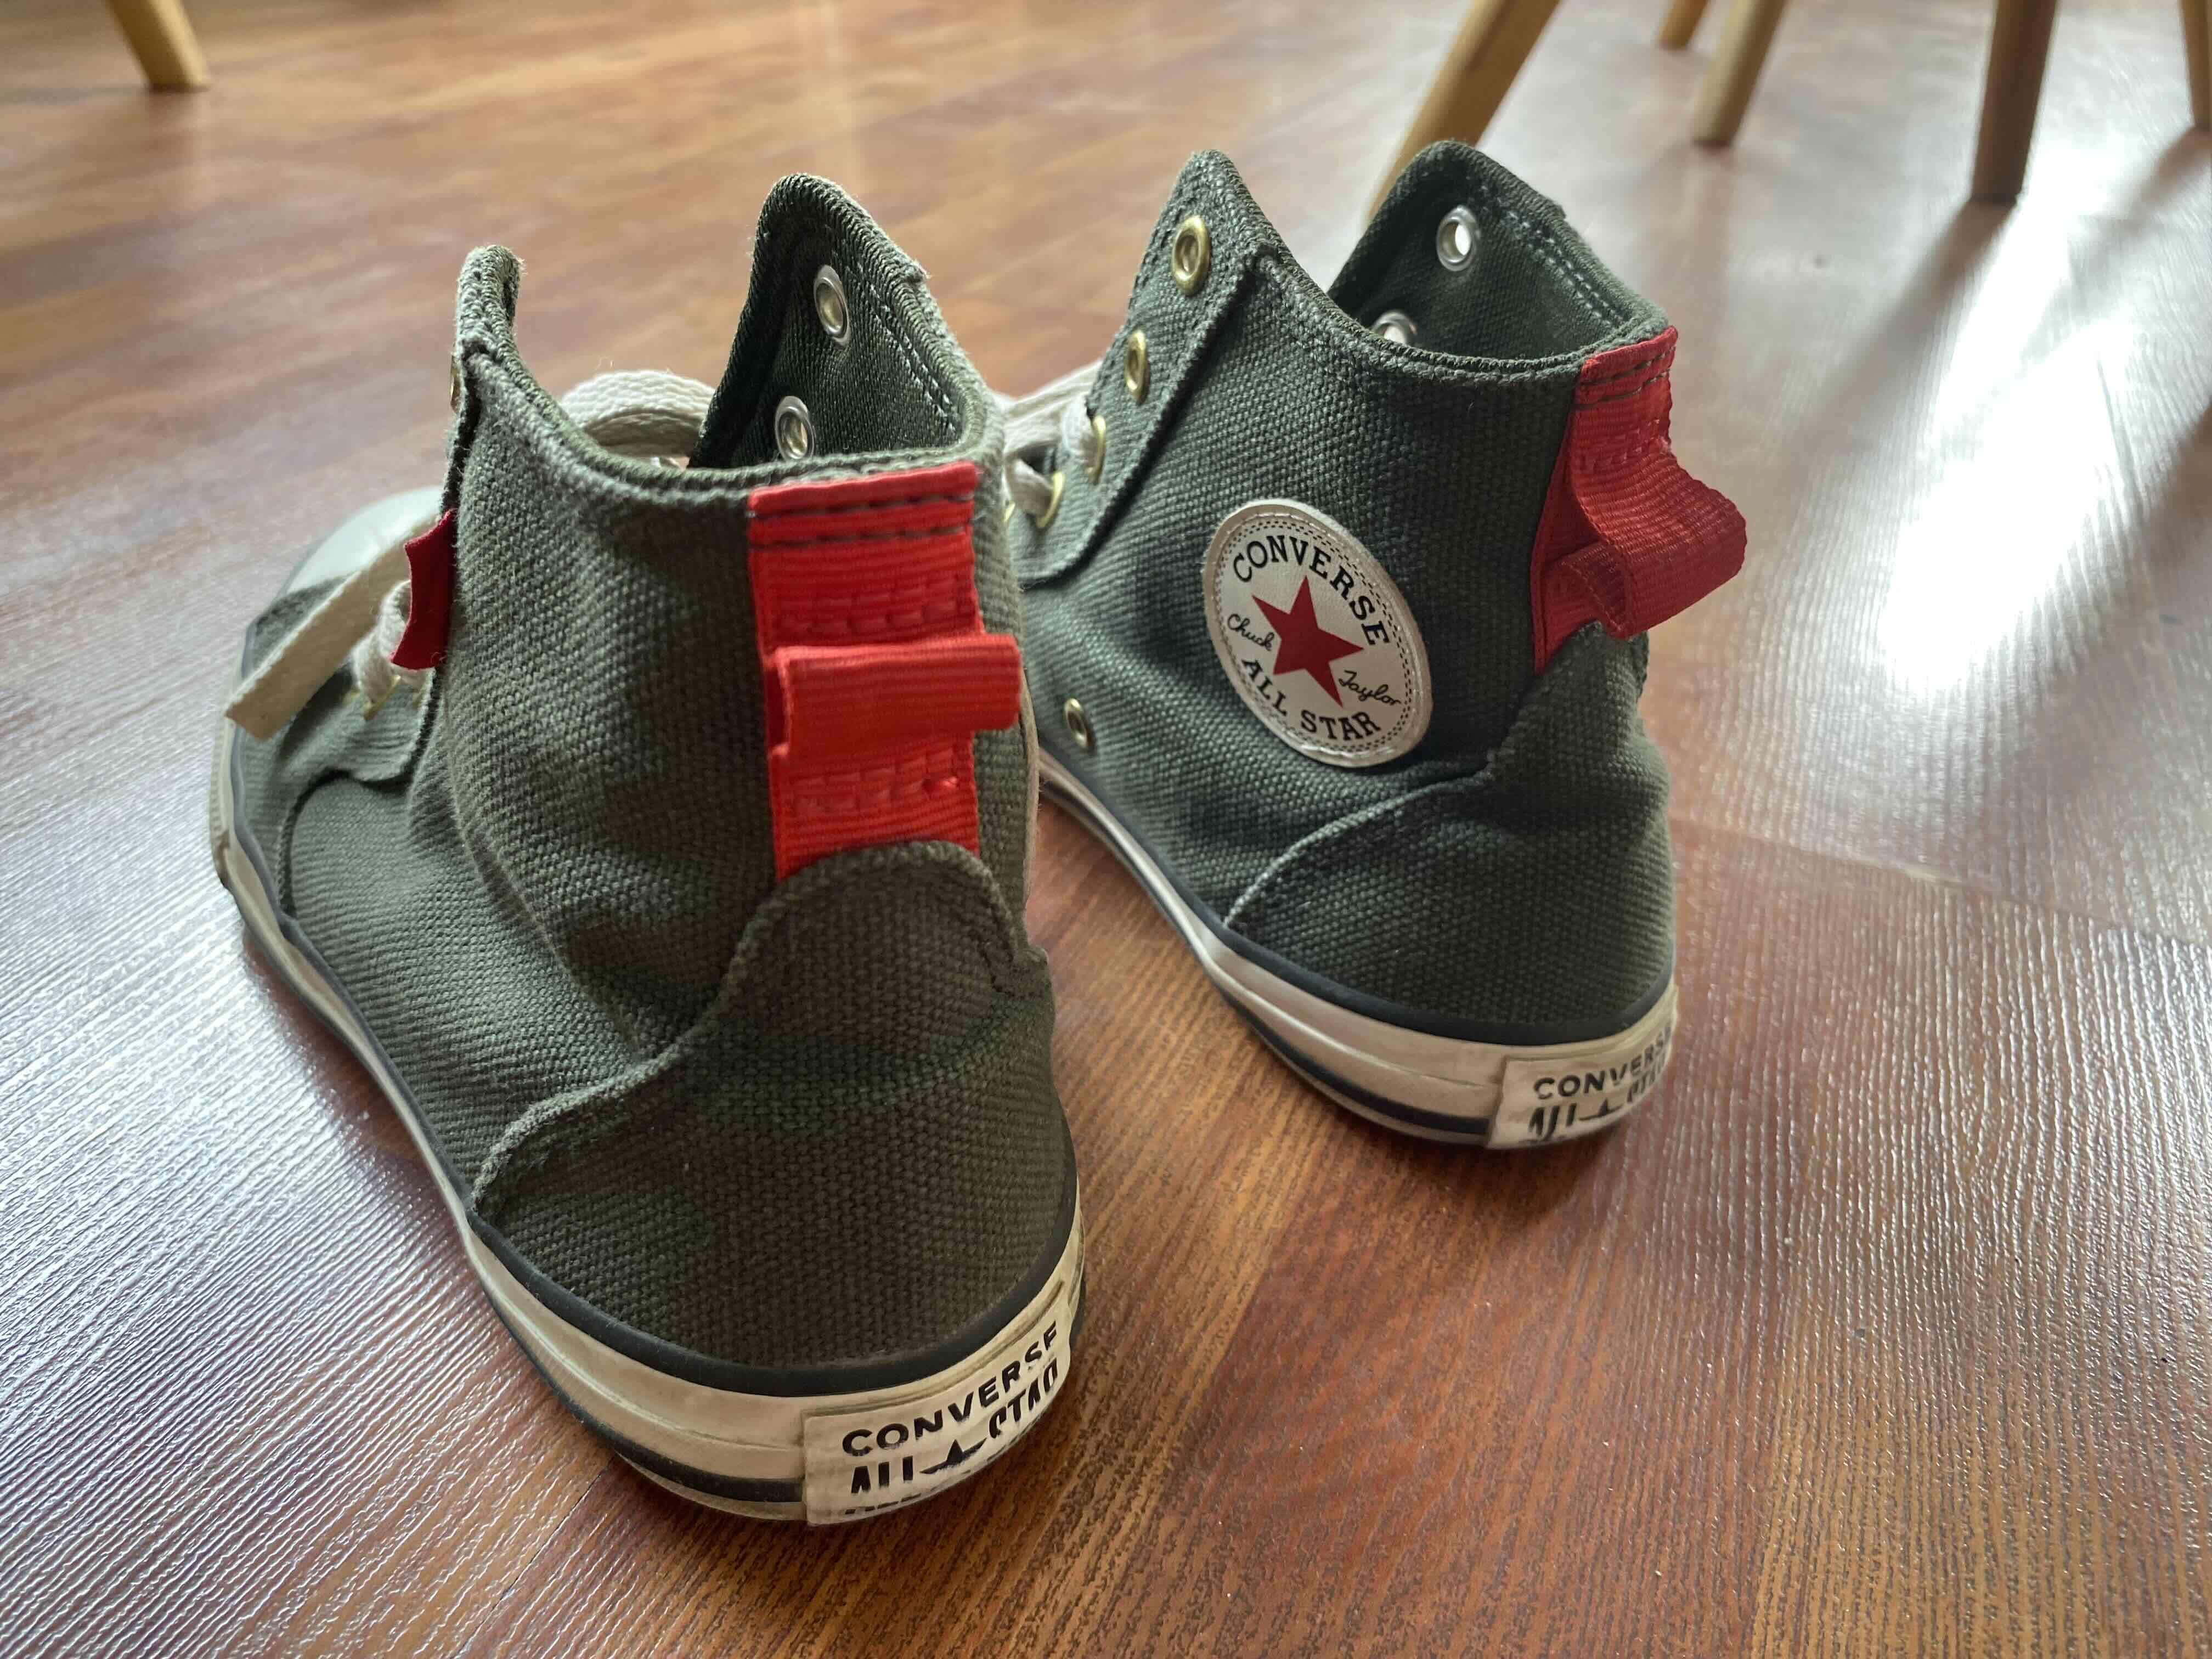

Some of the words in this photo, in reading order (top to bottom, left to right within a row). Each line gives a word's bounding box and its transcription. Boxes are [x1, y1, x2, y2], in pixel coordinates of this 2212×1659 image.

[1233, 535, 1390, 645] CONVERSE
[1227, 614, 1276, 651] Chuck
[1339, 670, 1401, 706] Taylor
[1242, 659, 1289, 716] ALL
[1301, 712, 1381, 741] STAR
